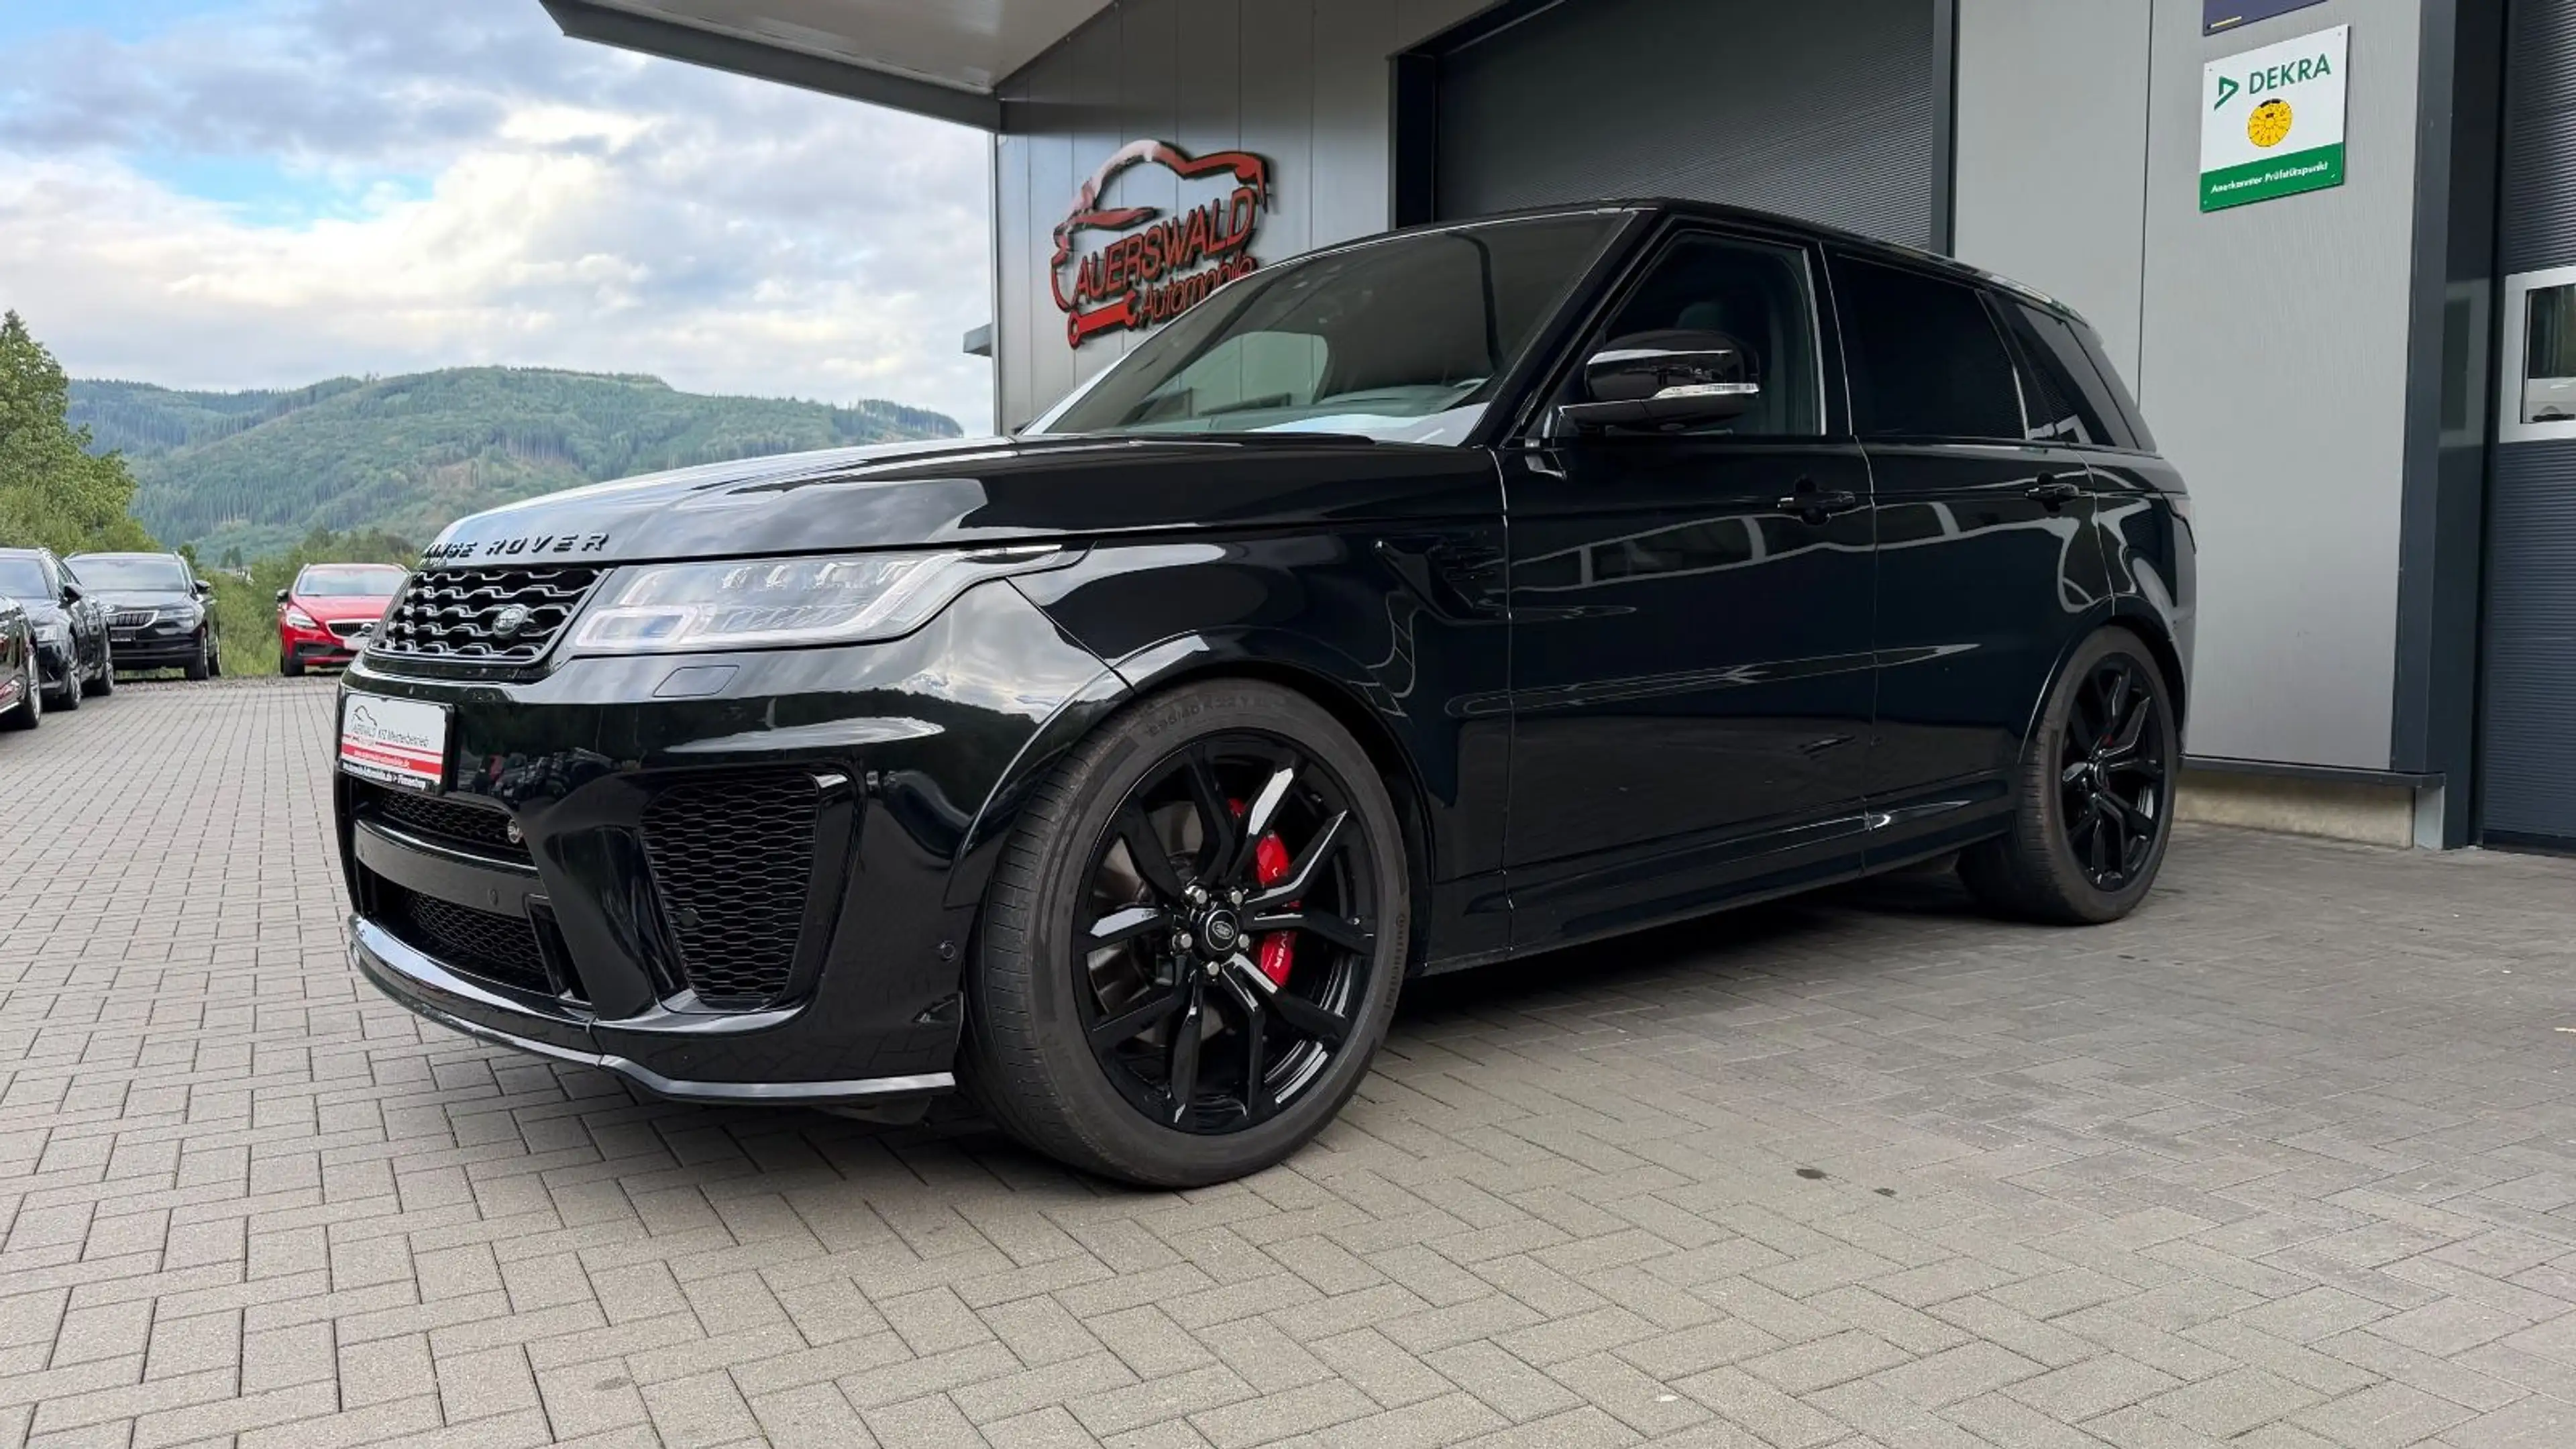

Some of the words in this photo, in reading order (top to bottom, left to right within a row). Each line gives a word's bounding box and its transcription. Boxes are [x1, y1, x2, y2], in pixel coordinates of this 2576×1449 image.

[2249, 53, 2332, 95] DEKRA
[1075, 186, 1256, 305] AUERSWALD
[485, 533, 610, 557] ROVER
